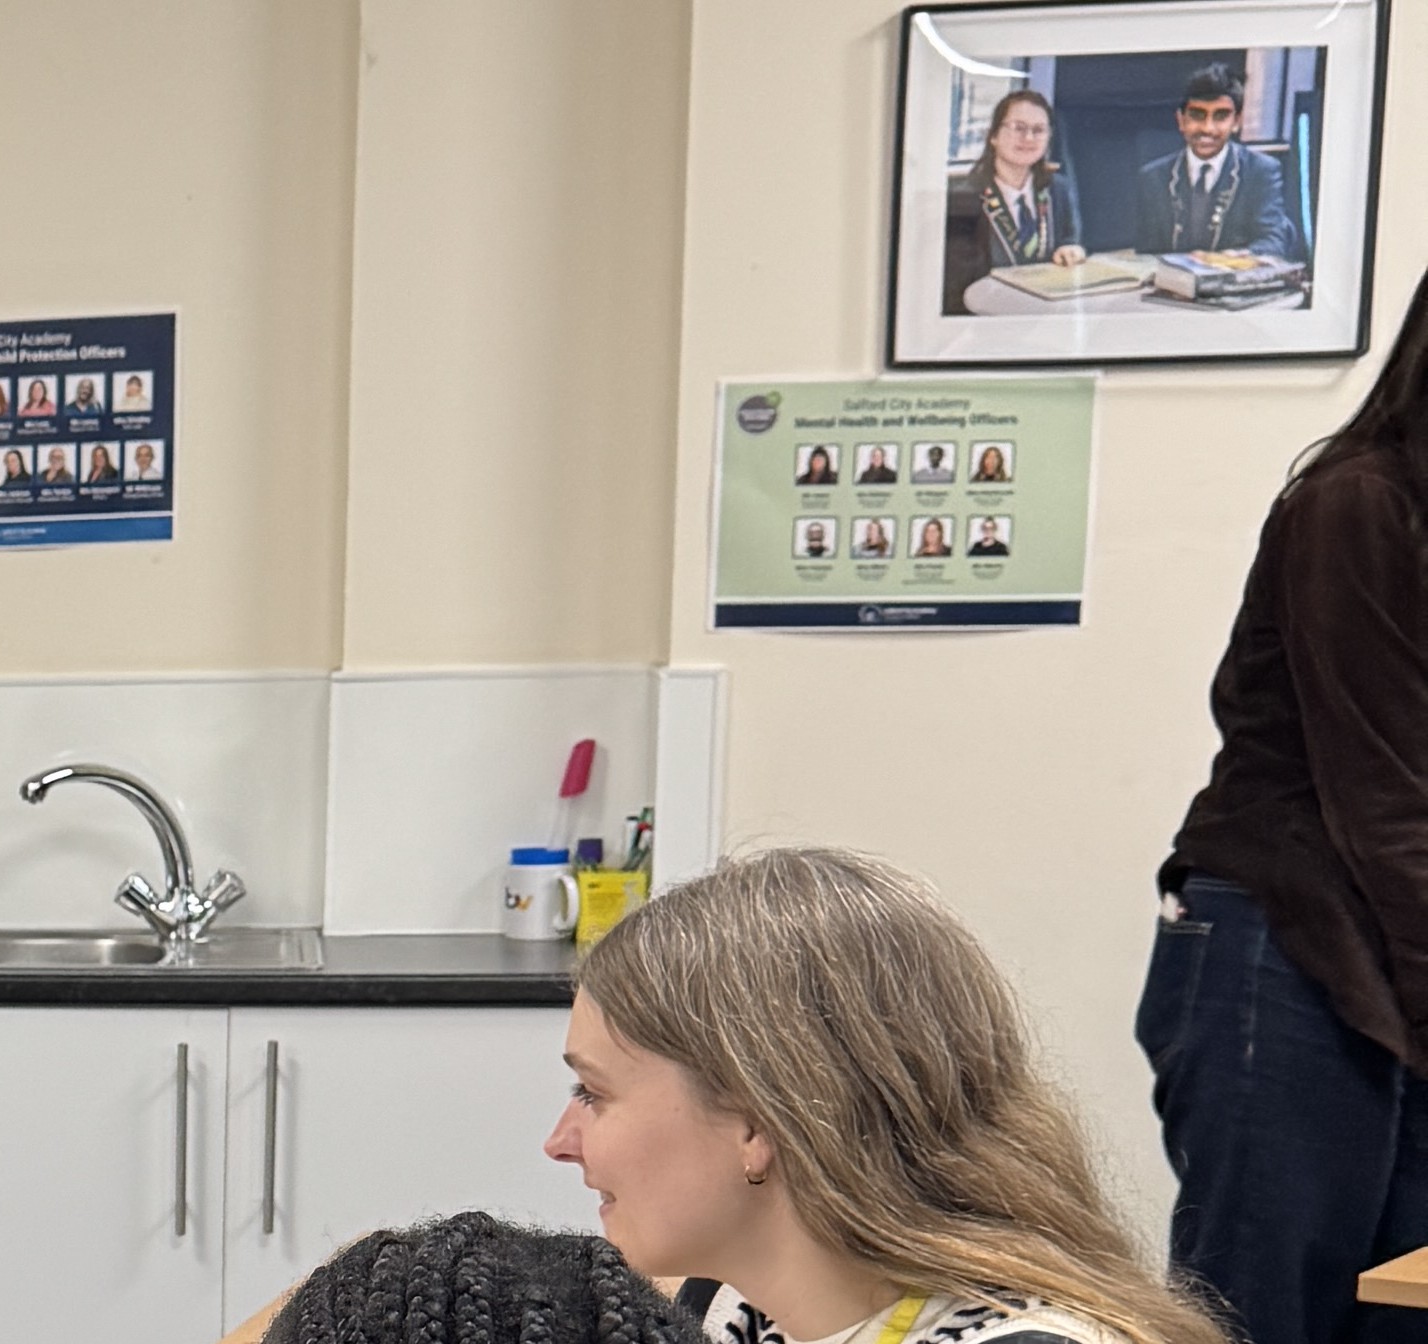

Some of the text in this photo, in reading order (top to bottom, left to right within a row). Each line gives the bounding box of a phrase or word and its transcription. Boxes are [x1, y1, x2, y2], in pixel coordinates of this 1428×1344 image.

[20, 332, 72, 347] Academy
[19, 347, 77, 363] Protection
[79, 345, 127, 360] Officers
[844, 398, 971, 411] Salford City Academy
[795, 412, 1019, 429] Mental Health and Wellbeing Officers
